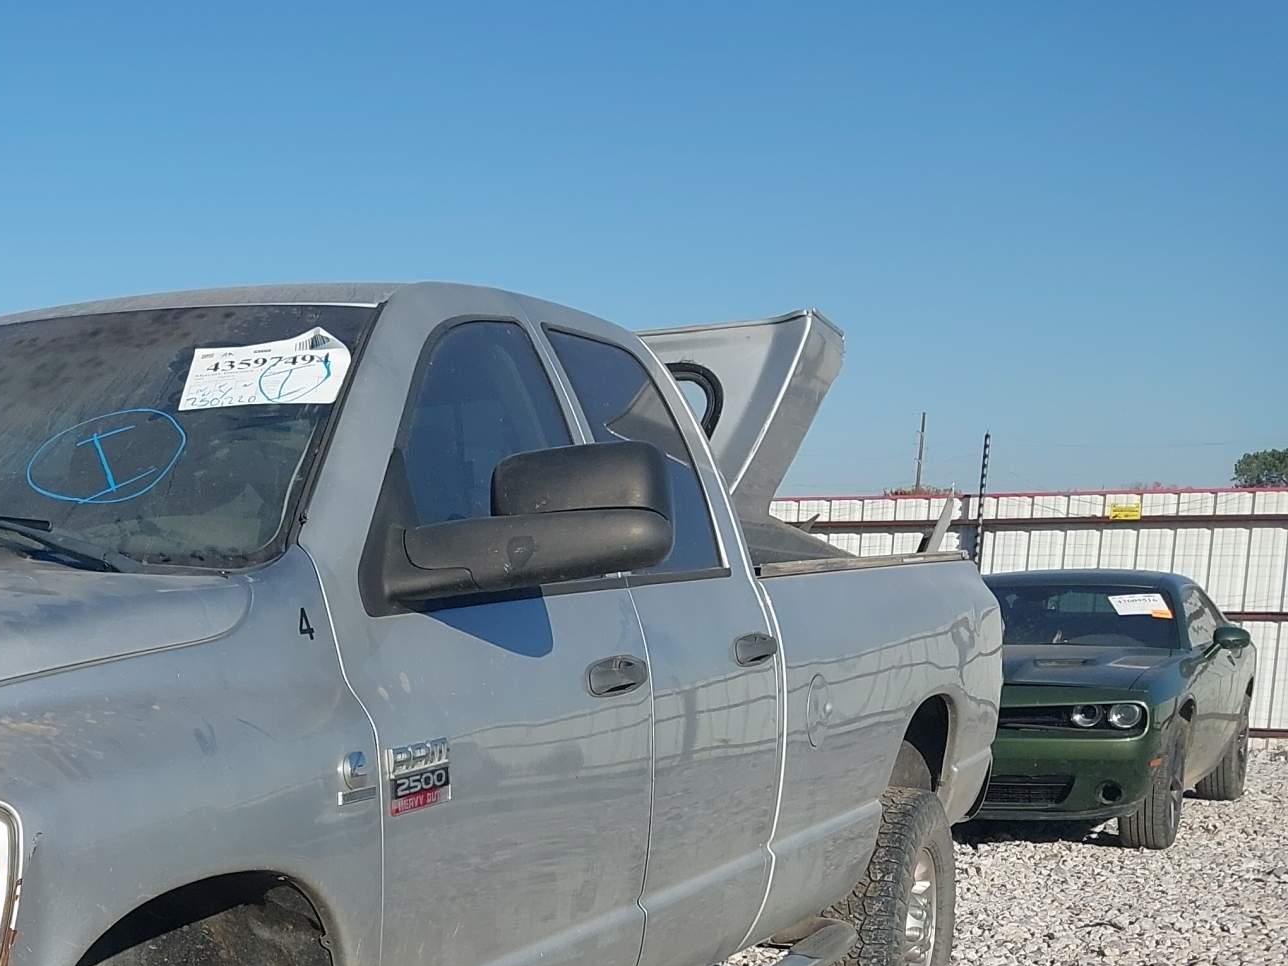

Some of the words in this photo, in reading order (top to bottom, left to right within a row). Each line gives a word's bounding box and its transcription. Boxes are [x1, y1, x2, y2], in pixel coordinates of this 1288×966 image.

[206, 352, 331, 373] 43597494
[298, 607, 315, 641] 4
[385, 736, 450, 780] RAM
[396, 769, 447, 797] 2500
